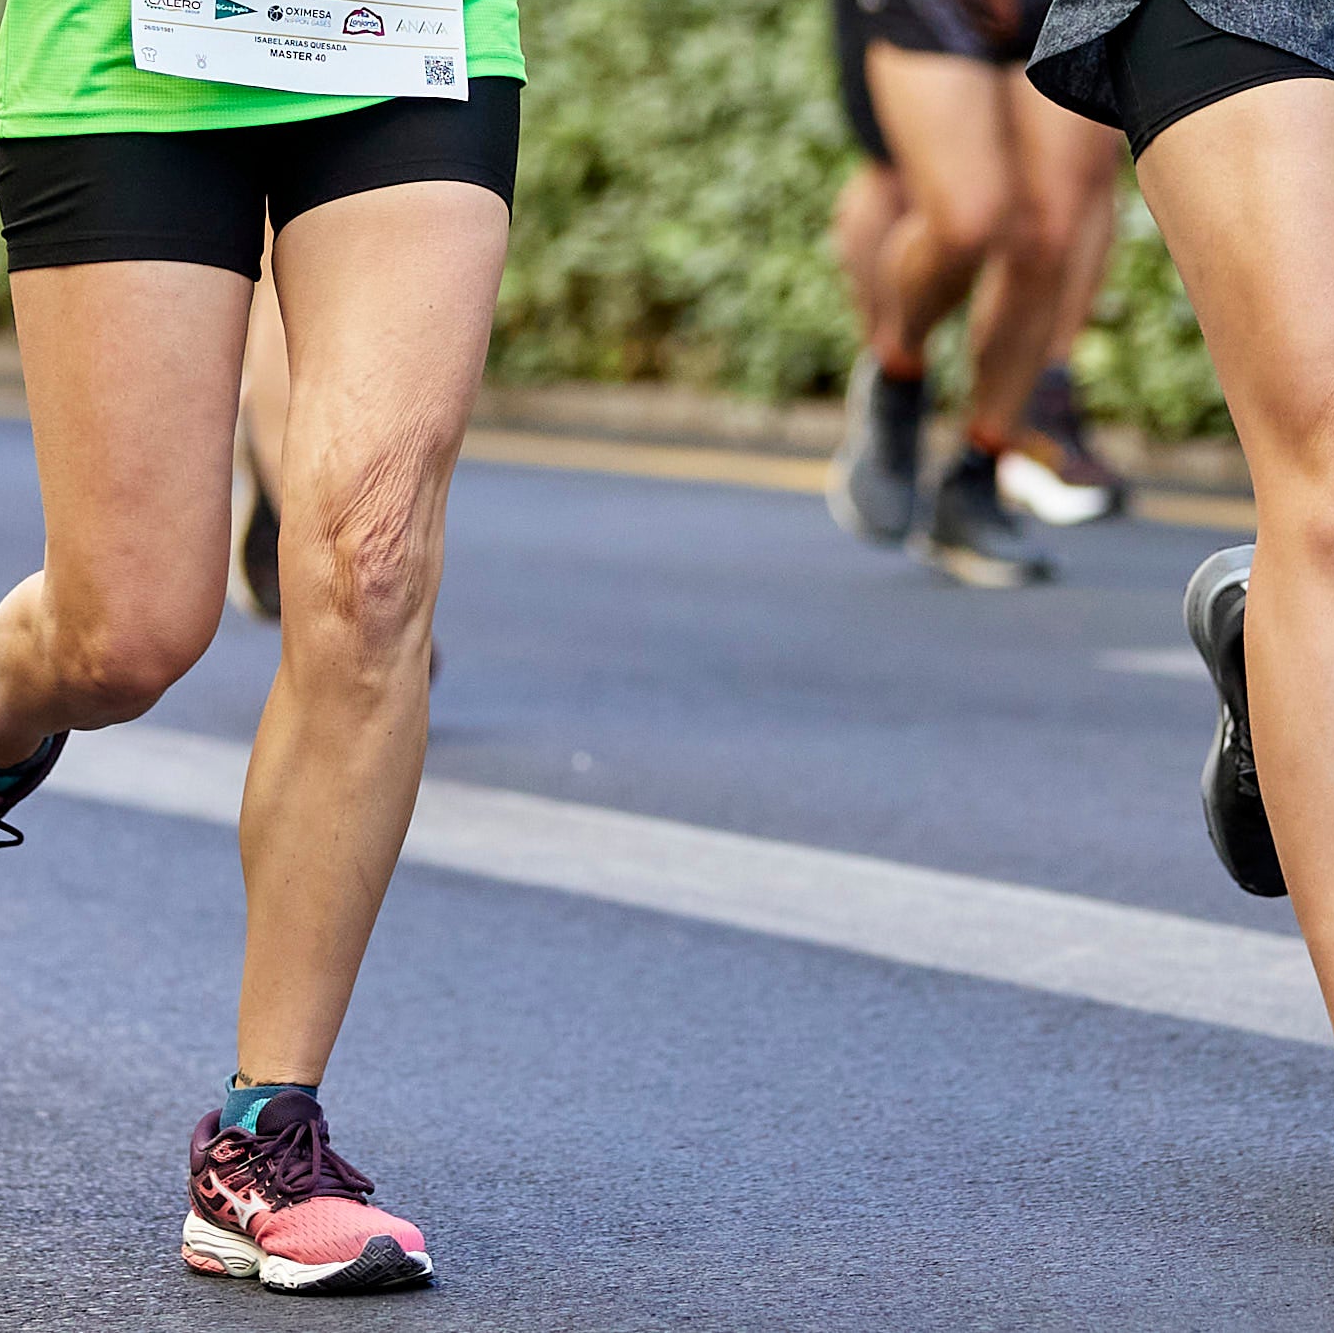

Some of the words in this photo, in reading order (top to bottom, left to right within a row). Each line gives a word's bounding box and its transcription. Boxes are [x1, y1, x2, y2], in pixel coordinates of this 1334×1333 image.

[285, 6, 332, 20] OXIMESA
[349, 17, 379, 30] Lanjarón
[254, 35, 283, 46] ISABEL
[284, 38, 309, 48] ARIAS
[310, 41, 348, 52] QUESADA
[269, 48, 313, 62] MASTER
[314, 53, 327, 63] 40
